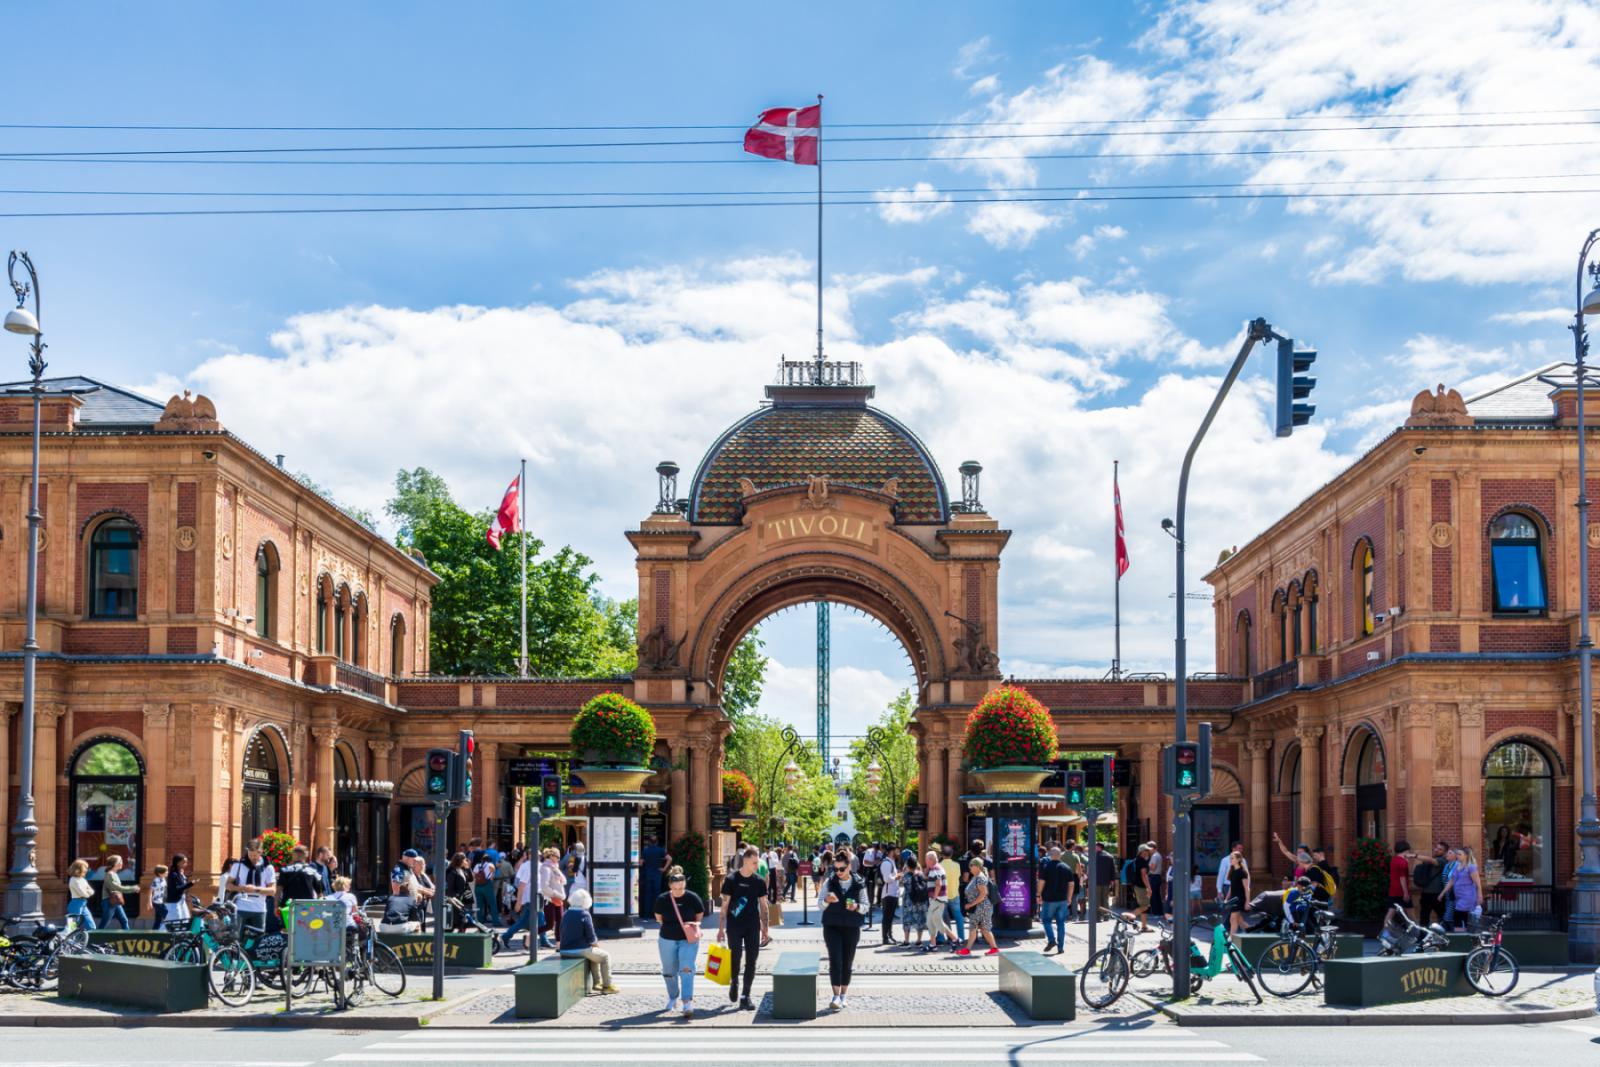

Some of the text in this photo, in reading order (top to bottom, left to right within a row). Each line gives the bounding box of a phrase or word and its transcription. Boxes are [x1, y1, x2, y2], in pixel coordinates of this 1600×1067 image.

[784, 361, 855, 385] TIVOLI
[768, 515, 865, 539] TIVOLI
[392, 942, 460, 959] TIVOLI
[1401, 967, 1448, 992] TIVOLI
